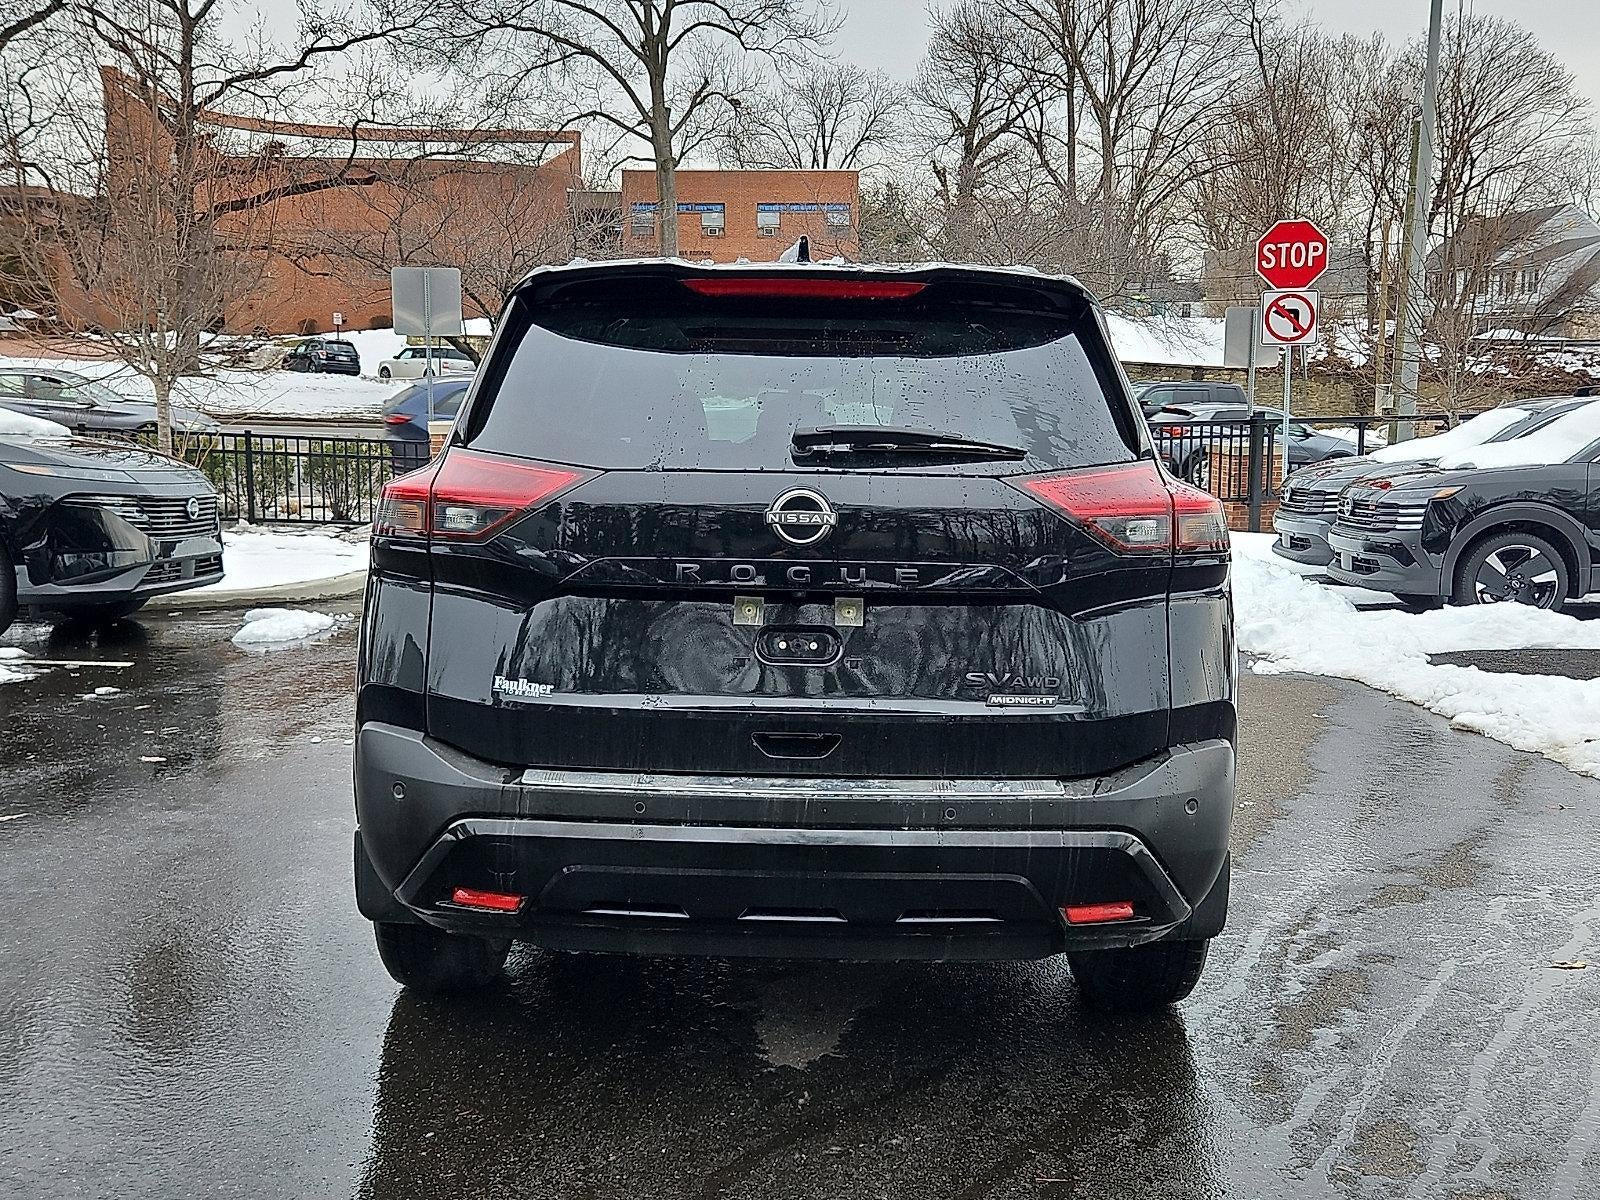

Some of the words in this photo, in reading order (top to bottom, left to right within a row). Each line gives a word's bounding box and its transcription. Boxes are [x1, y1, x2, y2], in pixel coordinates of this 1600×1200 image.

[1261, 241, 1324, 269] STOP
[768, 513, 834, 523] NISSAN
[675, 563, 920, 583] ROGUE
[493, 675, 554, 694] Faulkner
[965, 672, 1011, 688] SV
[1010, 676, 1060, 688] AWD
[990, 696, 1056, 705] MIDNIGHT
